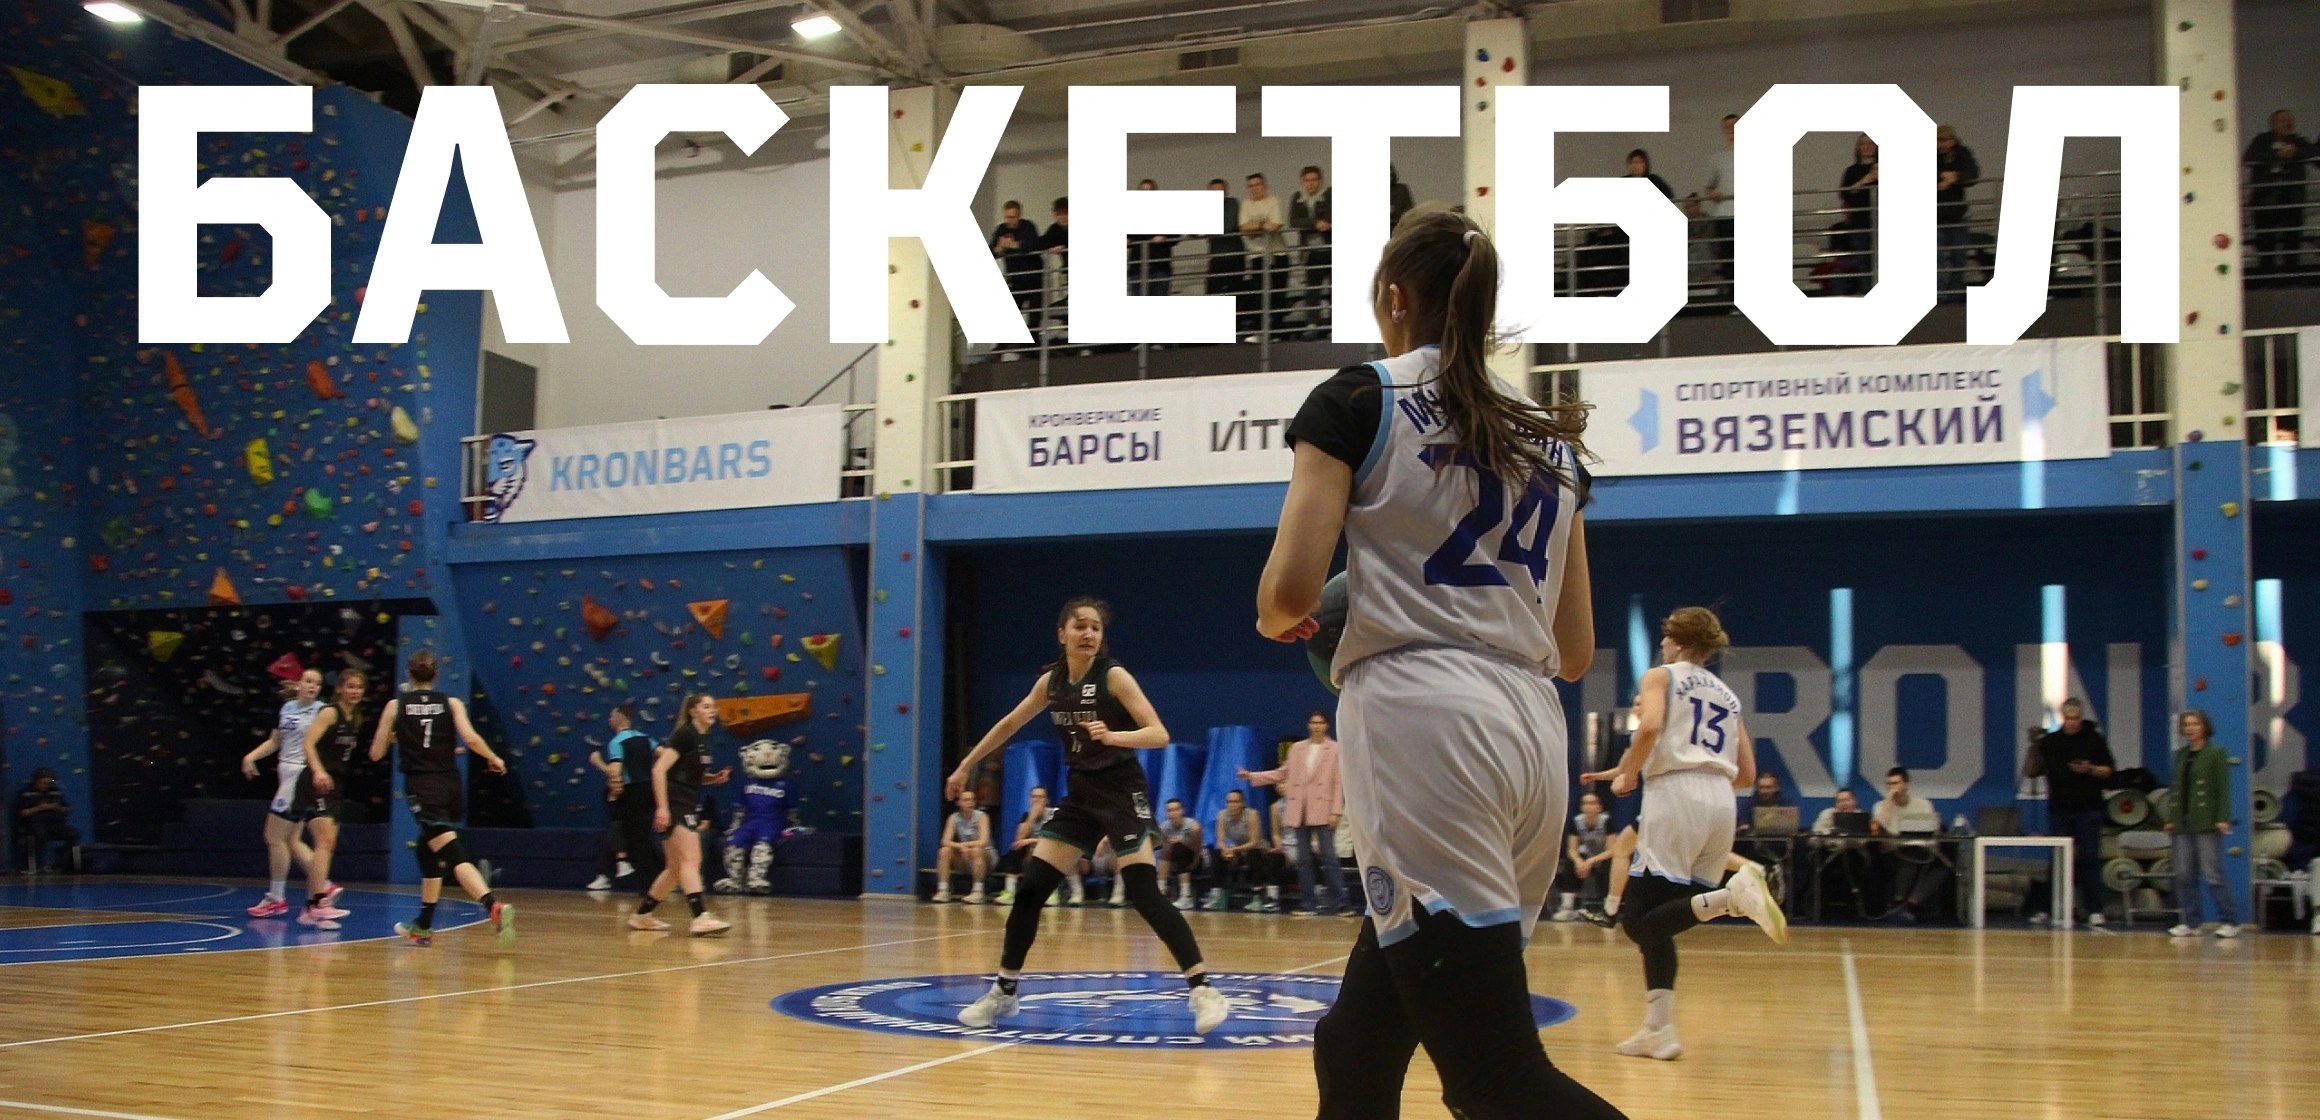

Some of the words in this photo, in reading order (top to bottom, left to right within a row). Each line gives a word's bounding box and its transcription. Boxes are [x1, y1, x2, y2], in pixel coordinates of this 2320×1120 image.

[1675, 372, 1850, 402] СПОРТИВНЫЙ
[1857, 369, 2002, 394] КОМПЛЕКС
[1028, 407, 1162, 429] КРОНВЕРКСКИЕ
[1677, 395, 2004, 455] ВЯЗЕМСКИЙ
[549, 439, 772, 492] KRONBARS
[1028, 431, 1161, 467] БАРСЫ
[1417, 443, 1560, 588] 24
[420, 718, 434, 749] 7
[1688, 696, 1729, 754] 13
